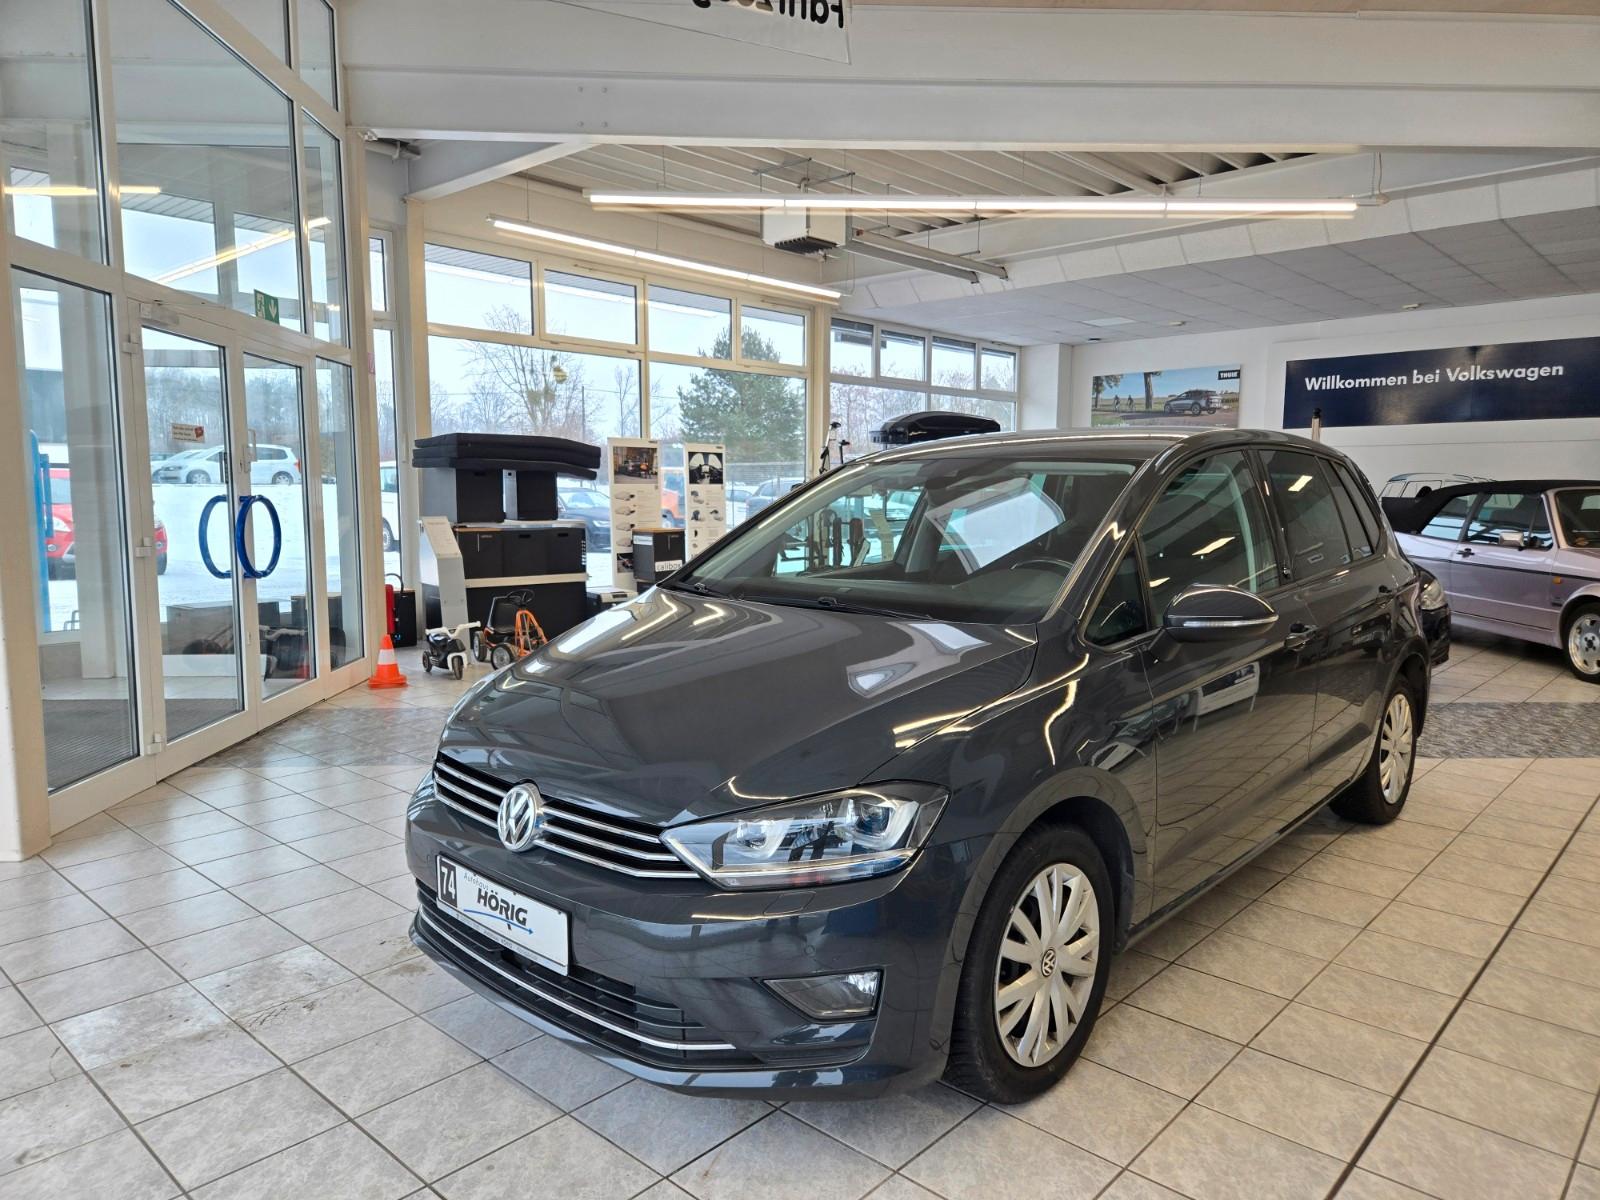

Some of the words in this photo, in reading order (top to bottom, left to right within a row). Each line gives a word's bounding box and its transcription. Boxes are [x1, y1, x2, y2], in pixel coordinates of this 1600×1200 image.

[1219, 371, 1238, 379] THULE
[1304, 374, 1408, 391] Willkommen
[1412, 369, 1440, 384] bei
[1446, 365, 1564, 381] Volkswagen
[441, 866, 456, 900] 74
[477, 887, 528, 931] HÖRIG
